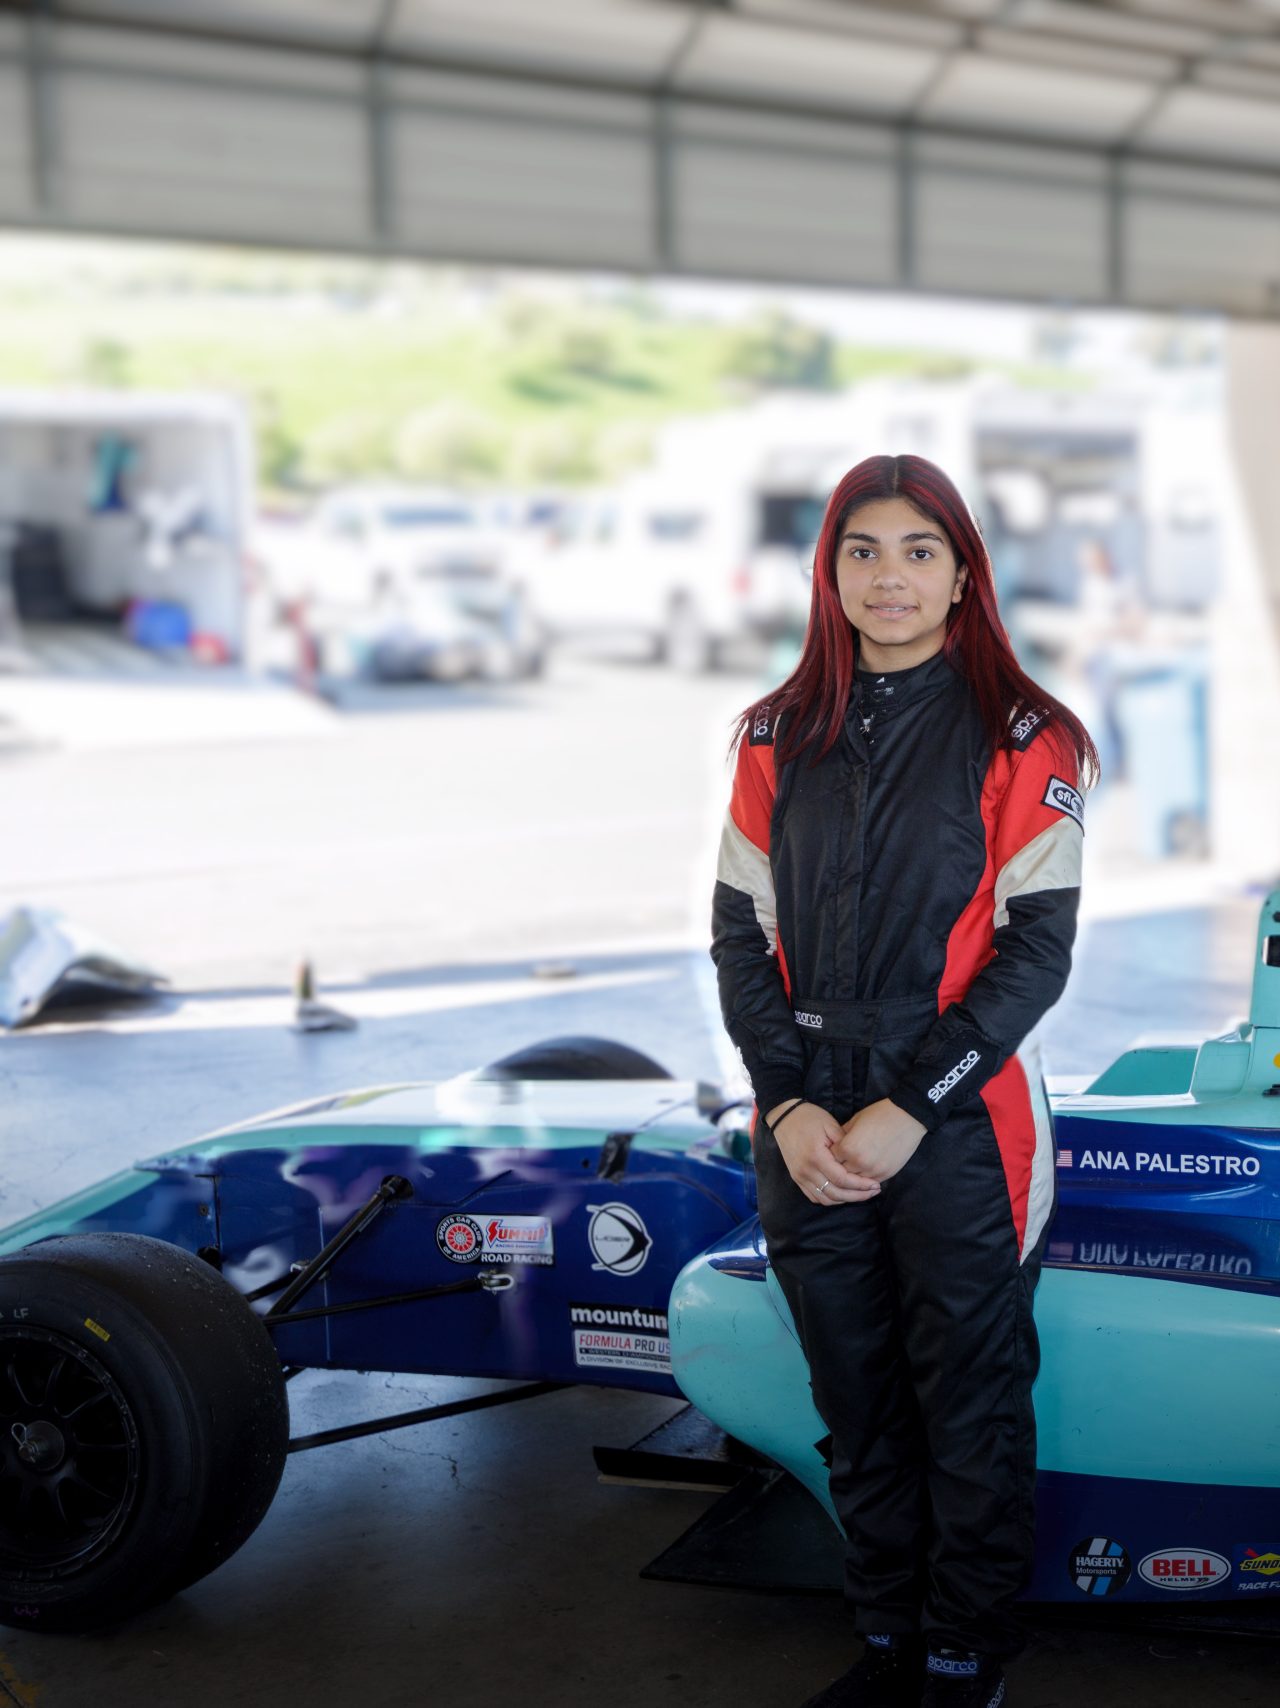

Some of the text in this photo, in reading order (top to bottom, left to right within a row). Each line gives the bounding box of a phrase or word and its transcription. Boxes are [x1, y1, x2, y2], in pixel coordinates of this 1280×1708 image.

[927, 1050, 979, 1102] sparco
[1079, 1149, 1261, 1176] ANA PALESTRO
[438, 1216, 483, 1241] SPORTS CAR CLUB
[452, 1246, 481, 1260] AMERICA
[481, 1253, 553, 1265] ROAD RACING
[13, 1307, 29, 1319] LF
[571, 1307, 668, 1331] mountun
[579, 1333, 671, 1355] FORMULA PRO US
[1075, 1556, 1124, 1568] HAGERTY
[1152, 1559, 1217, 1577] BELL
[1075, 1567, 1117, 1576] Motorsports
[1237, 1581, 1269, 1591] RACE
[927, 1655, 978, 1674] sparco
